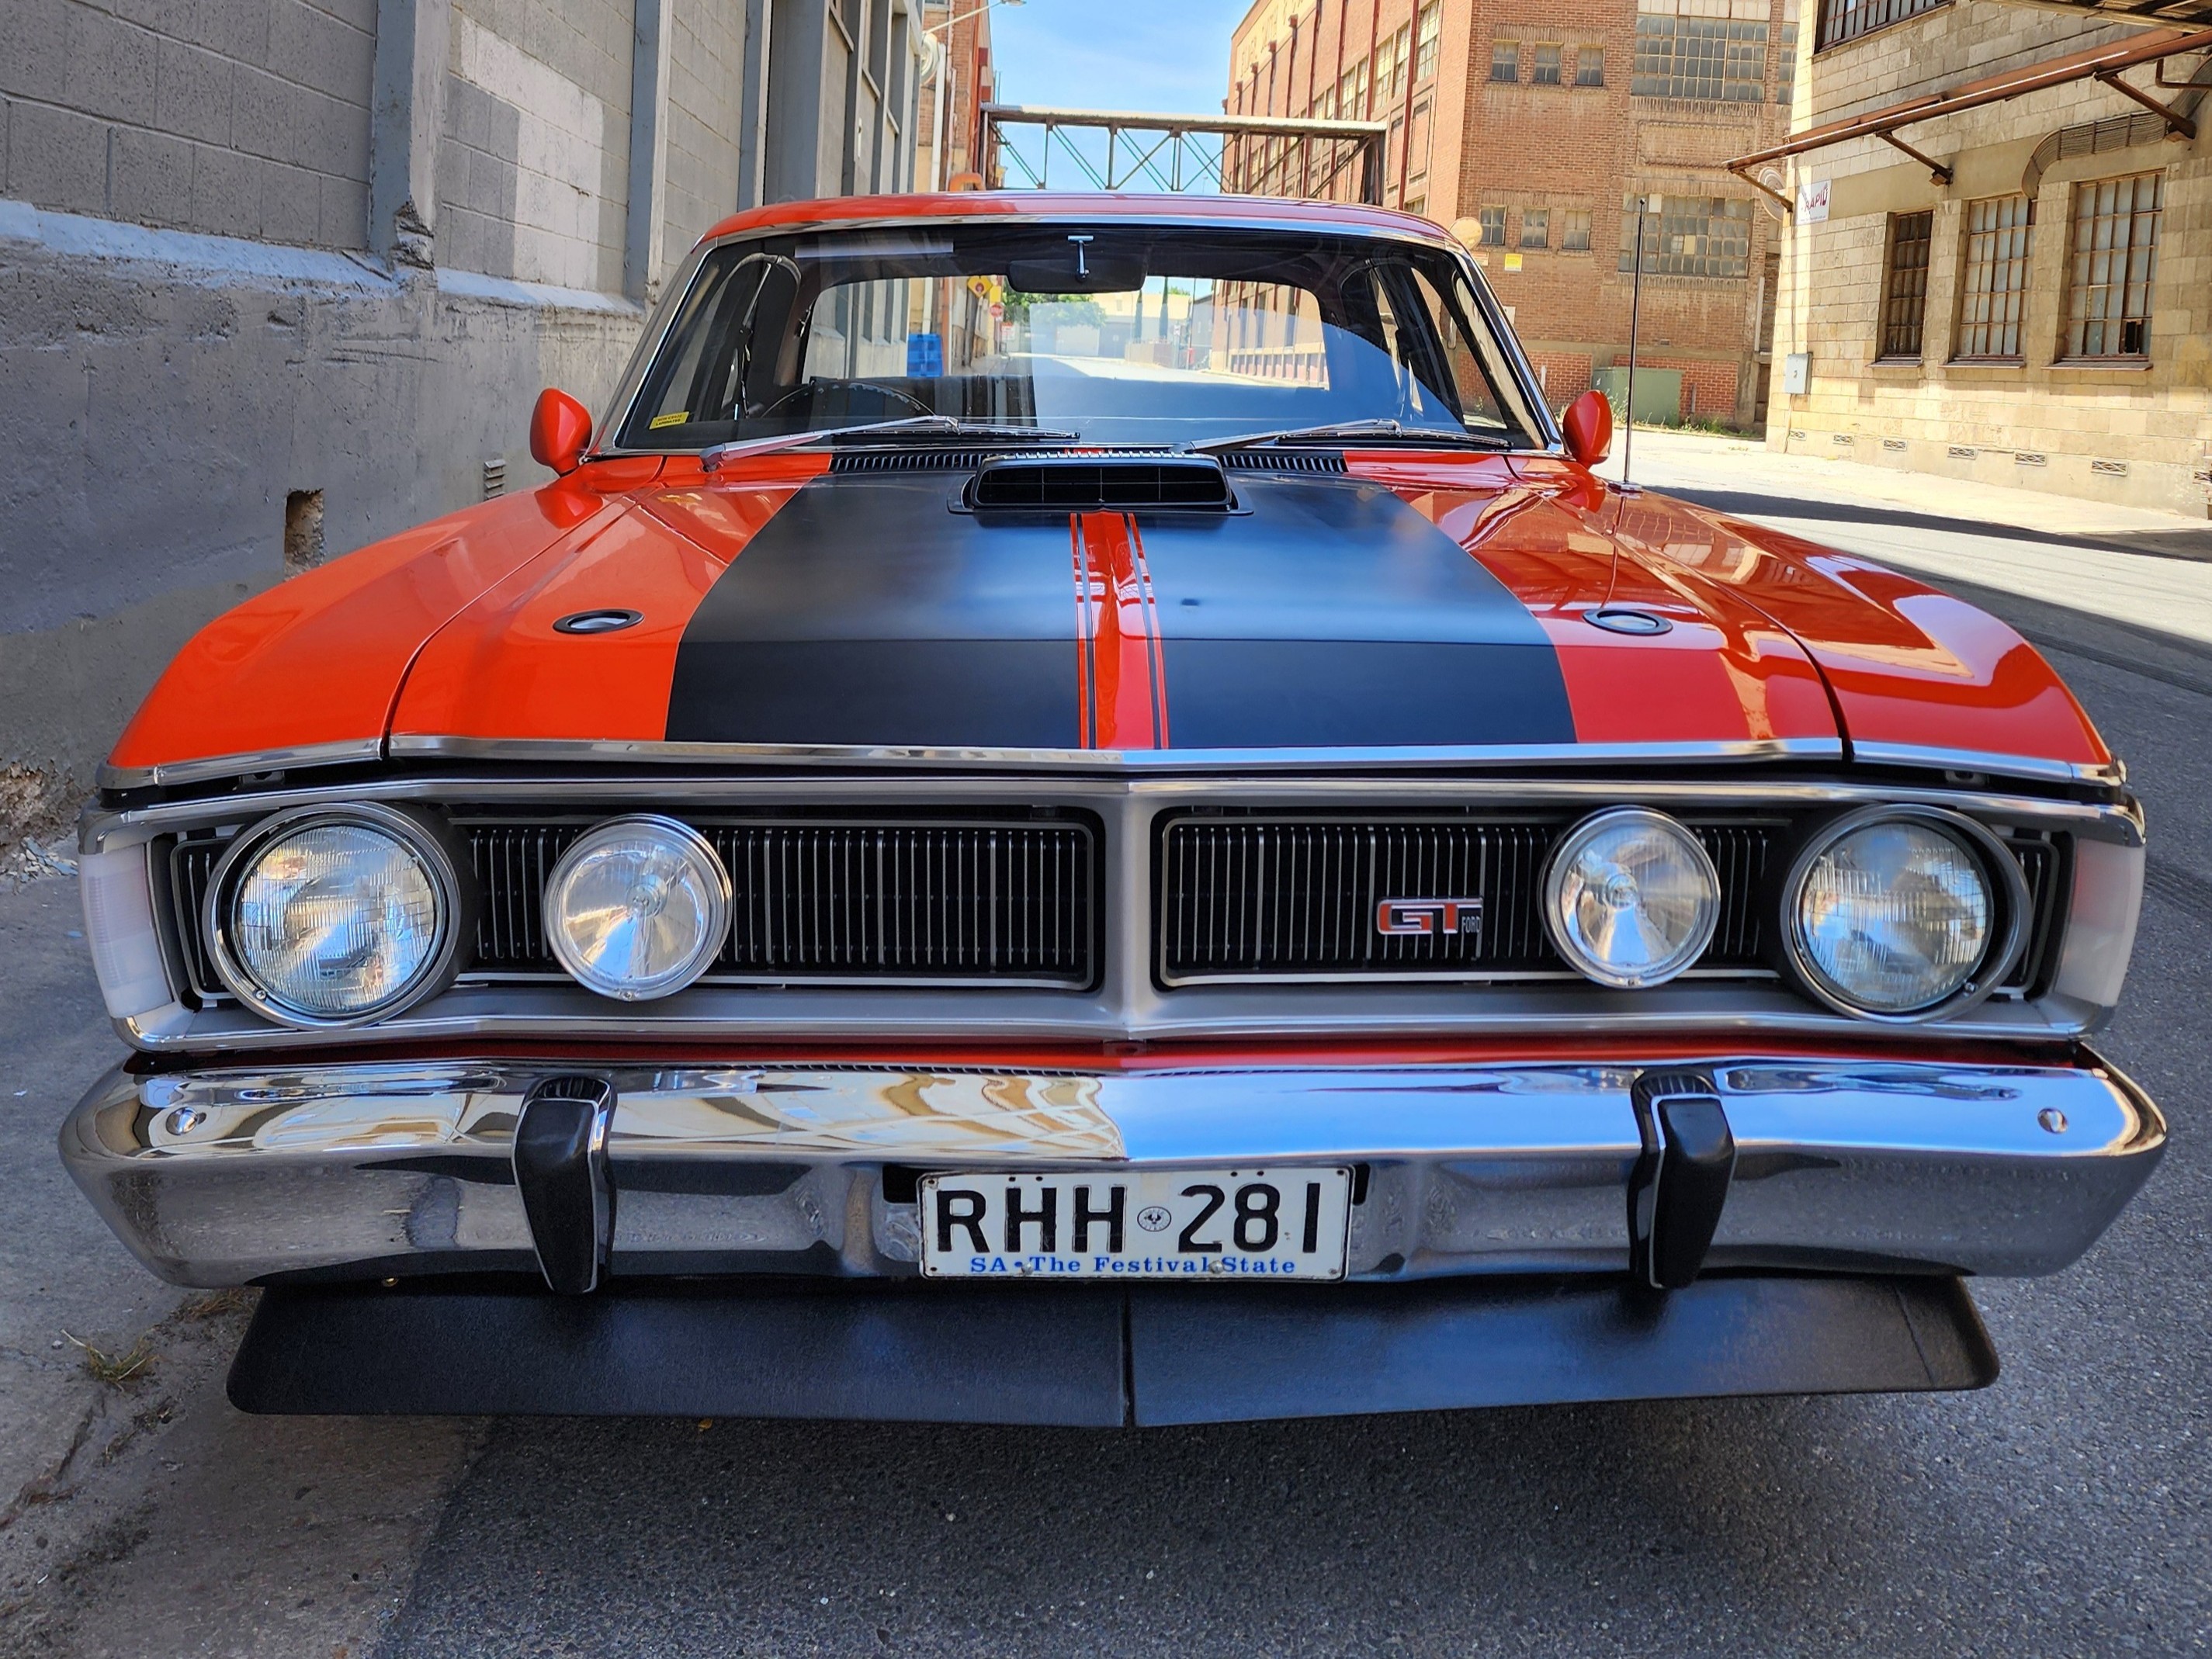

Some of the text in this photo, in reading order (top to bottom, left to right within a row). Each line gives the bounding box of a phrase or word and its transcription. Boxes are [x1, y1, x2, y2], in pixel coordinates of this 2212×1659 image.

[1378, 898, 1483, 935] GT
[1461, 916, 1481, 933] FORD
[936, 1183, 1321, 1253] RHH 281
[969, 1255, 1296, 1273] SA The Festival State
